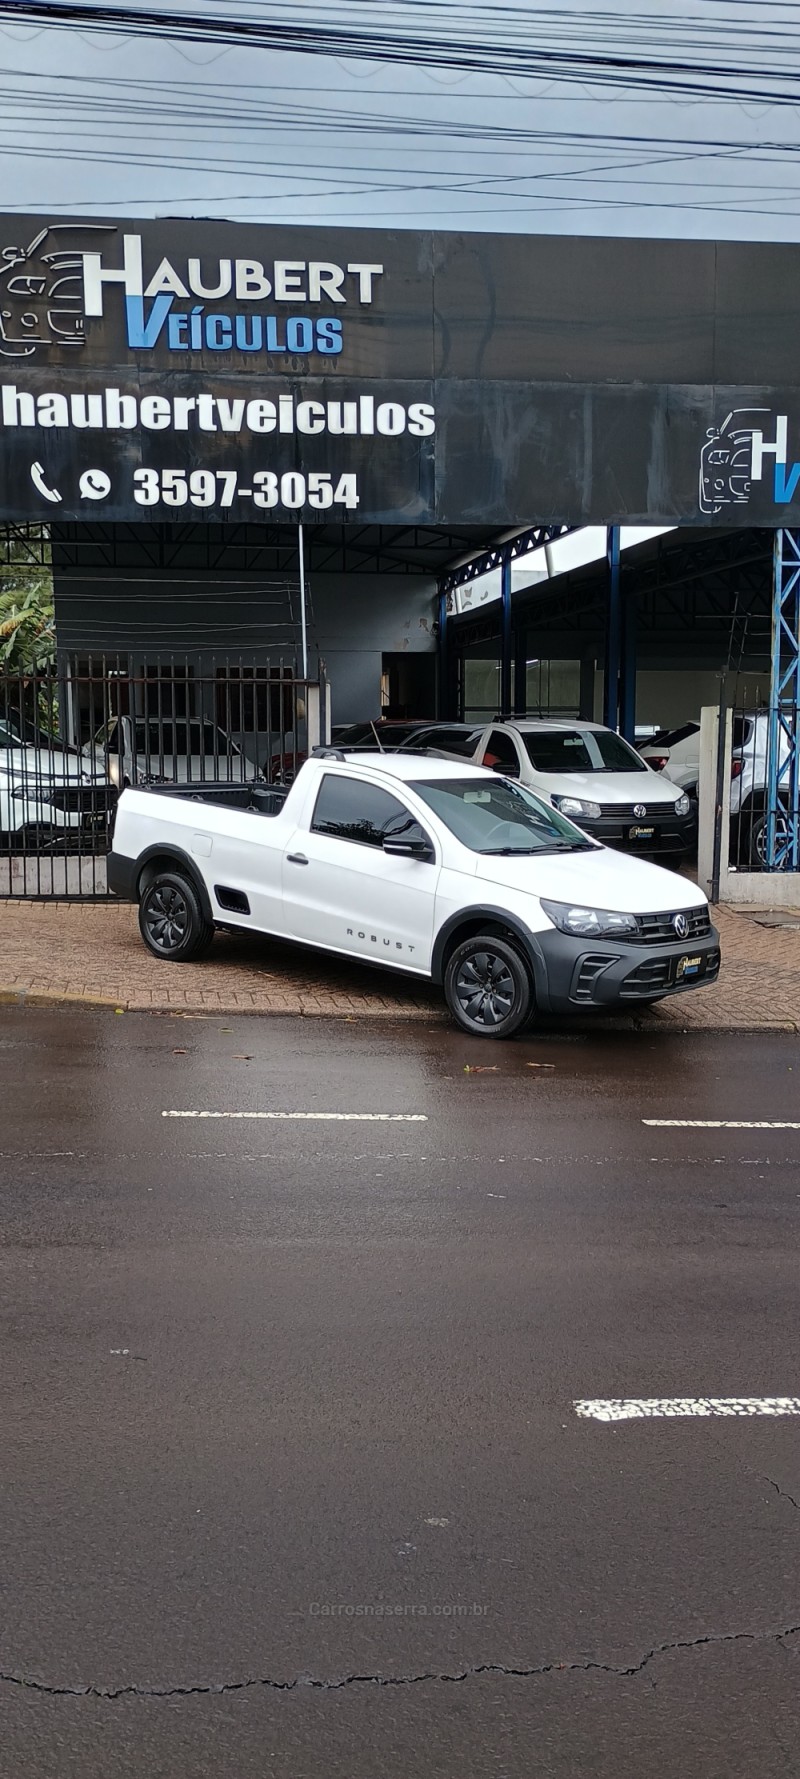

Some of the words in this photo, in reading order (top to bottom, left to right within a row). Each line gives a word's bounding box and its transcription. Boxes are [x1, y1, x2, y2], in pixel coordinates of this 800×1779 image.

[82, 234, 384, 316] HAUBERT
[125, 295, 344, 354] VEÍCULOS
[2, 385, 436, 437] haubertveiculos
[133, 468, 360, 510] 3597-3054
[346, 928, 415, 952] ROBUST
